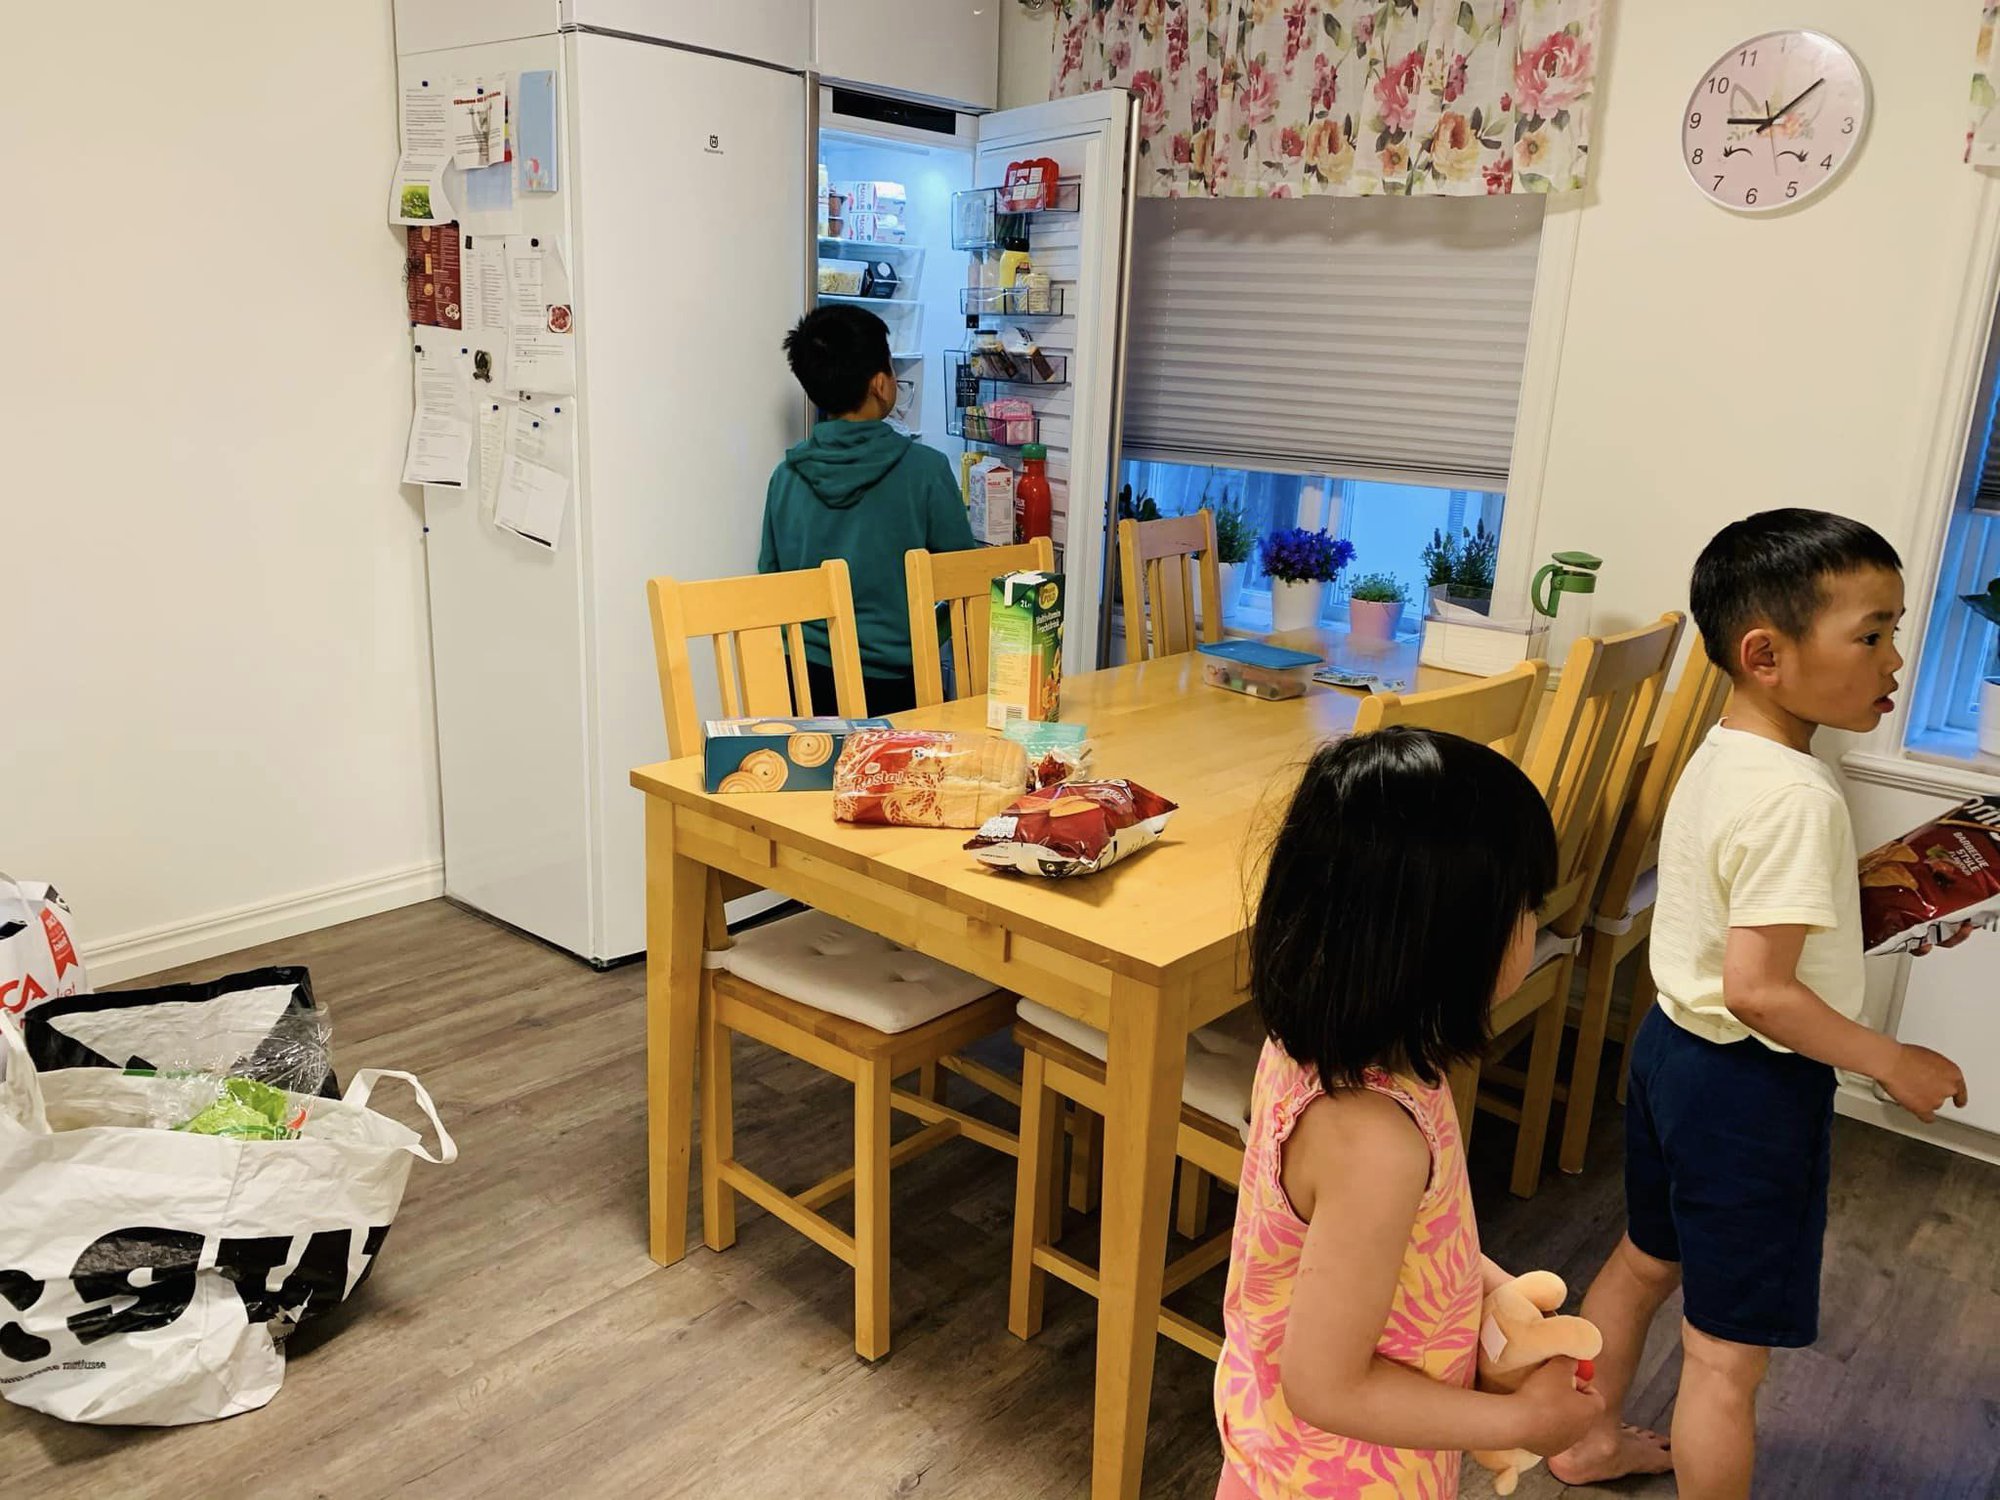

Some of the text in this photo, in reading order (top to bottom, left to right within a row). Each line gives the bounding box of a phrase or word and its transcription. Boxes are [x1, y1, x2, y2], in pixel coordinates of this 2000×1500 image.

[1739, 50, 1758, 67] 11
[1707, 76, 1730, 94] 10
[1689, 112, 1702, 129] 9
[1841, 116, 1854, 134] 3
[1691, 148, 1704, 165] 8
[1820, 154, 1832, 170] 4
[1713, 175, 1725, 192] 7
[1785, 181, 1799, 198] 5
[1745, 188, 1758, 205] 6
[1953, 832, 1990, 869] BARBECUE
[1955, 848, 1981, 873] STYLE
[0, 973, 48, 1014] CA
